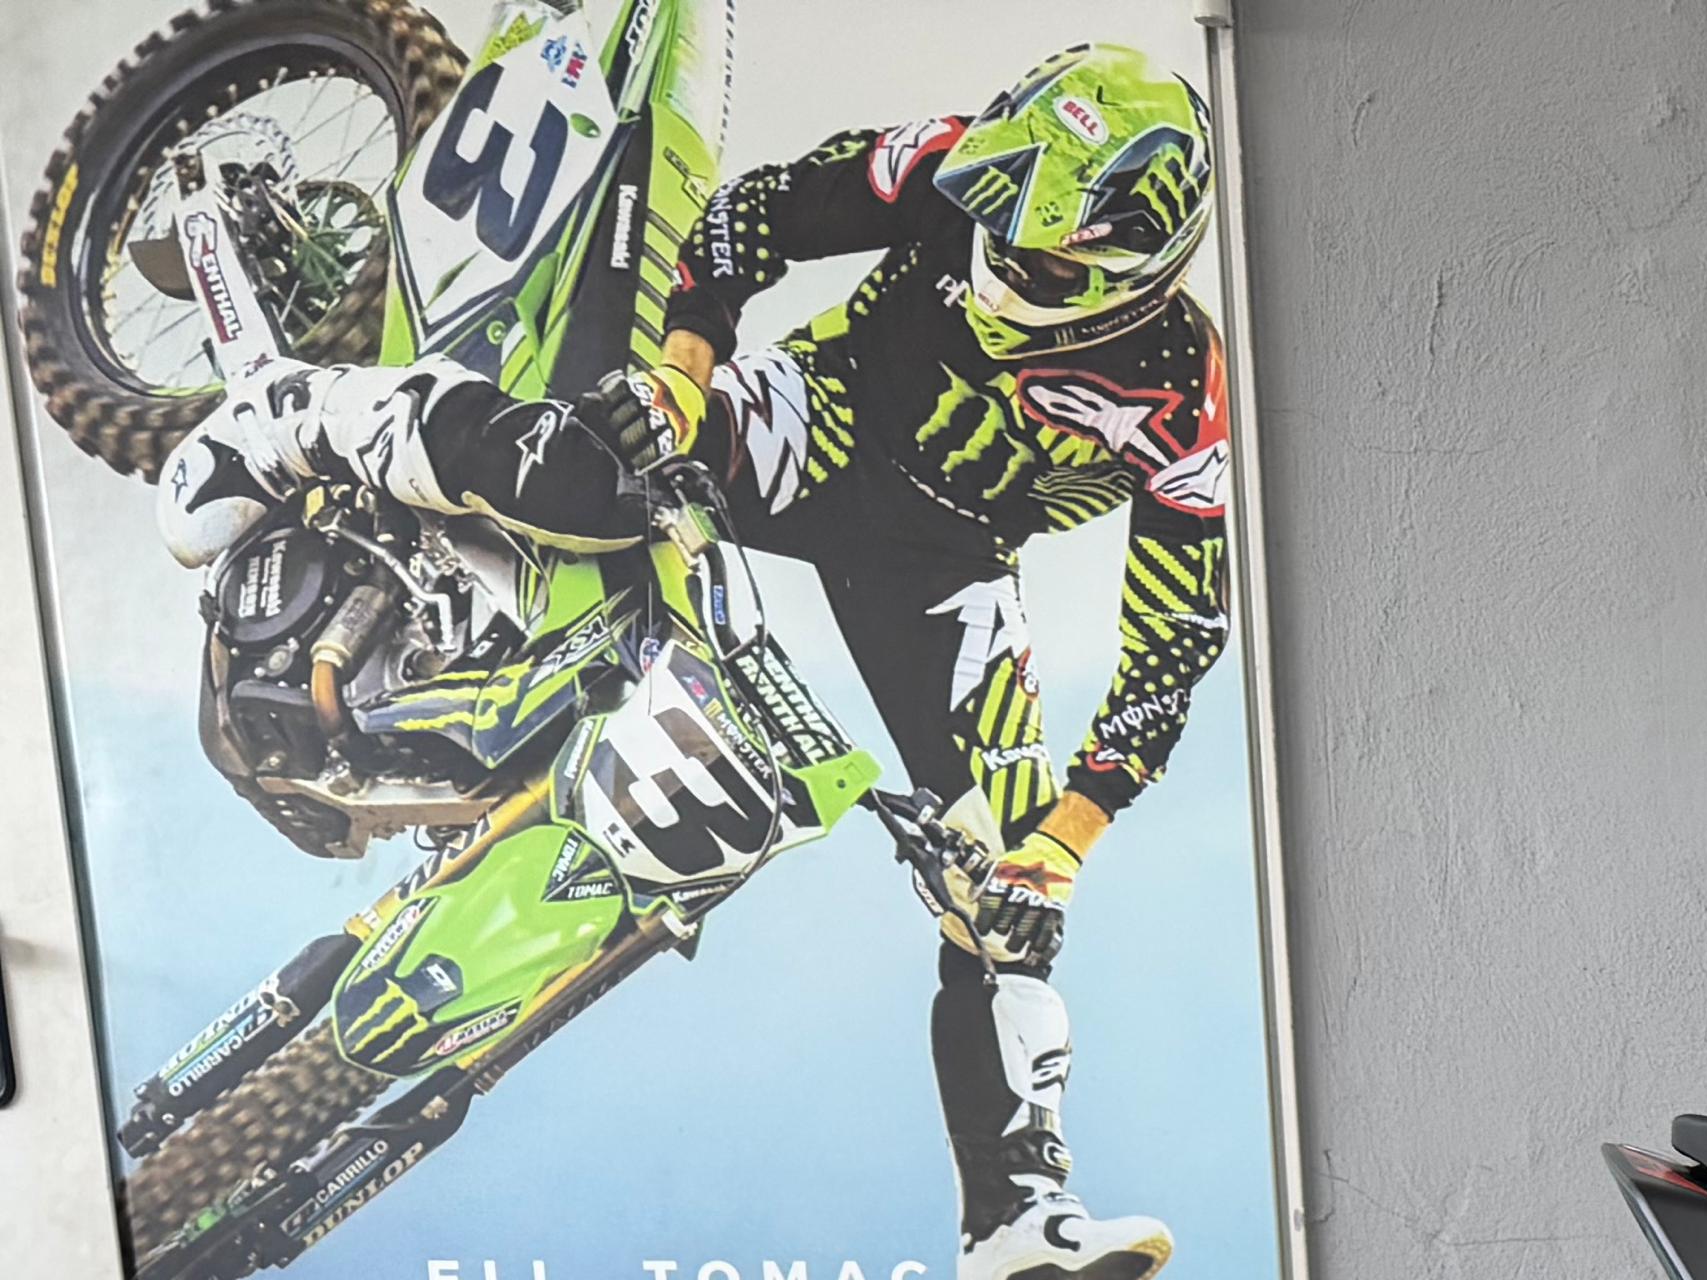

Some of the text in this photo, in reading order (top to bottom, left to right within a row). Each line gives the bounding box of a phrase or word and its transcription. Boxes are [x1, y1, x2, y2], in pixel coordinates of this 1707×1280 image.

[1062, 97, 1100, 137] BELL
[610, 183, 638, 269] Kawasaki
[549, 838, 579, 882] TOMAC
[566, 881, 614, 900] TOMAC
[168, 1035, 243, 1097] CARRILLO
[301, 1141, 425, 1249] DUNLOP
[316, 1139, 389, 1204] CARRILLO
